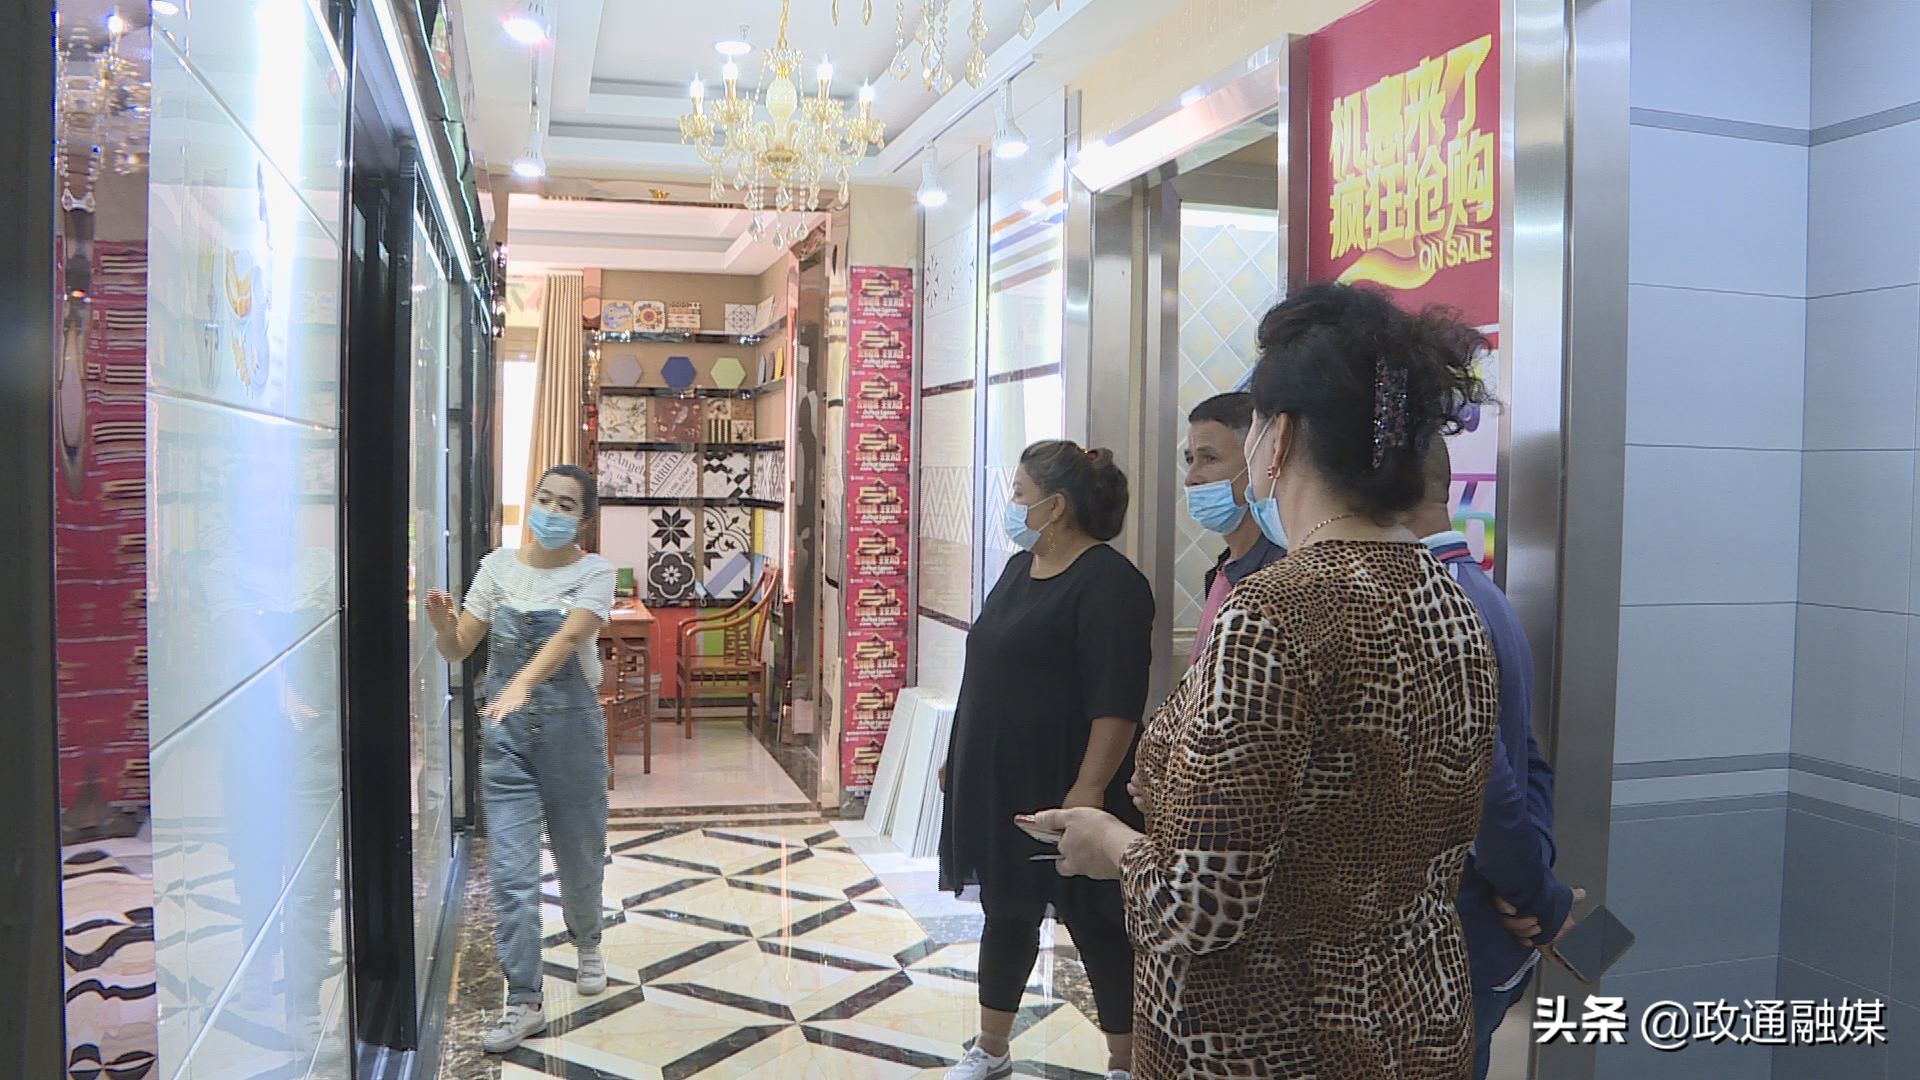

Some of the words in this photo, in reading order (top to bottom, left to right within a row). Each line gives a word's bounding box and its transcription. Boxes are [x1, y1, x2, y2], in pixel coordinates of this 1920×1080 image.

[1330, 129, 1494, 260] 疯狂抢购
[1419, 241, 1445, 272] ON
[1446, 230, 1493, 268] SALE
